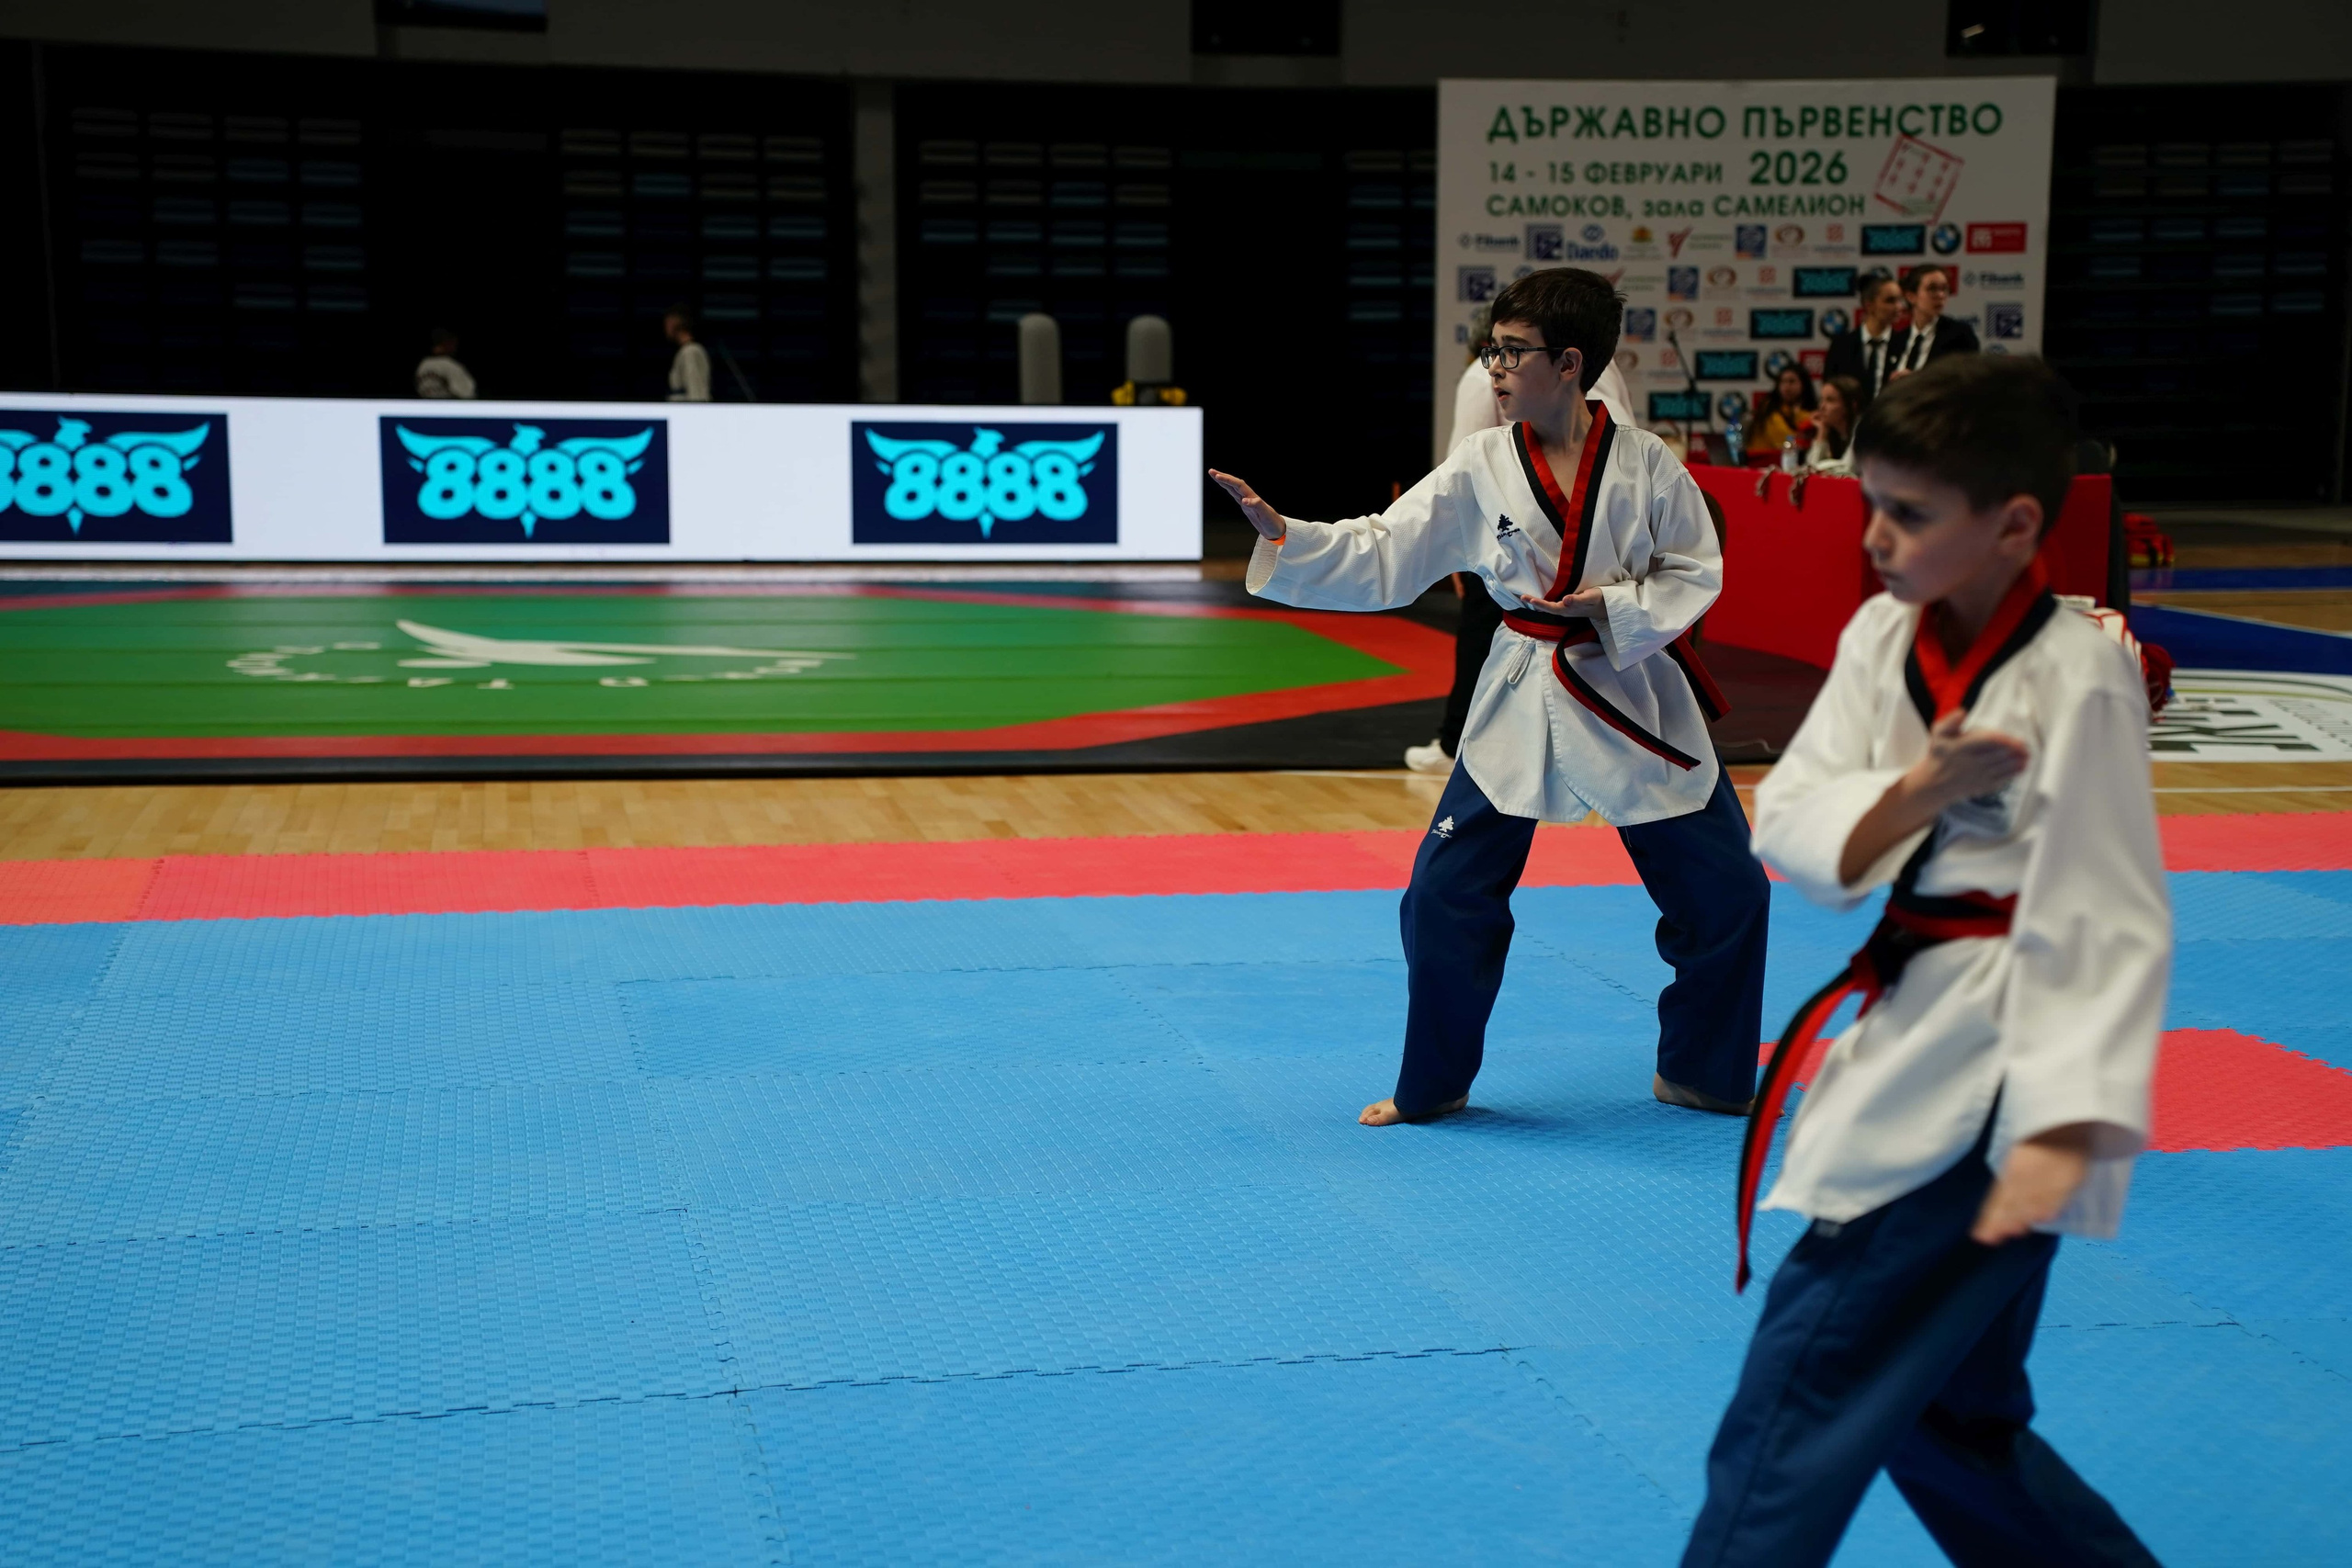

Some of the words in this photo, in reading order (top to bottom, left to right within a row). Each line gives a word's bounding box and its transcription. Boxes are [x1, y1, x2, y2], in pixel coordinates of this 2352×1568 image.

[1487, 106, 1726, 143] ДЪРЖАВНО
[1742, 102, 2004, 139] ПЪРВЕНСТВО
[1490, 162, 1516, 184] 14
[1549, 162, 1575, 184] 15
[1584, 161, 1724, 185] ФЕВРУАРИ
[1749, 151, 1849, 186] 2026
[1487, 194, 1632, 221] САМОКОВ,
[1642, 199, 1706, 218] зала
[1713, 193, 1866, 218] САМЕЛИОН
[0, 443, 193, 518] 888
[417, 448, 637, 520] 8888
[884, 451, 1090, 521] 8888
